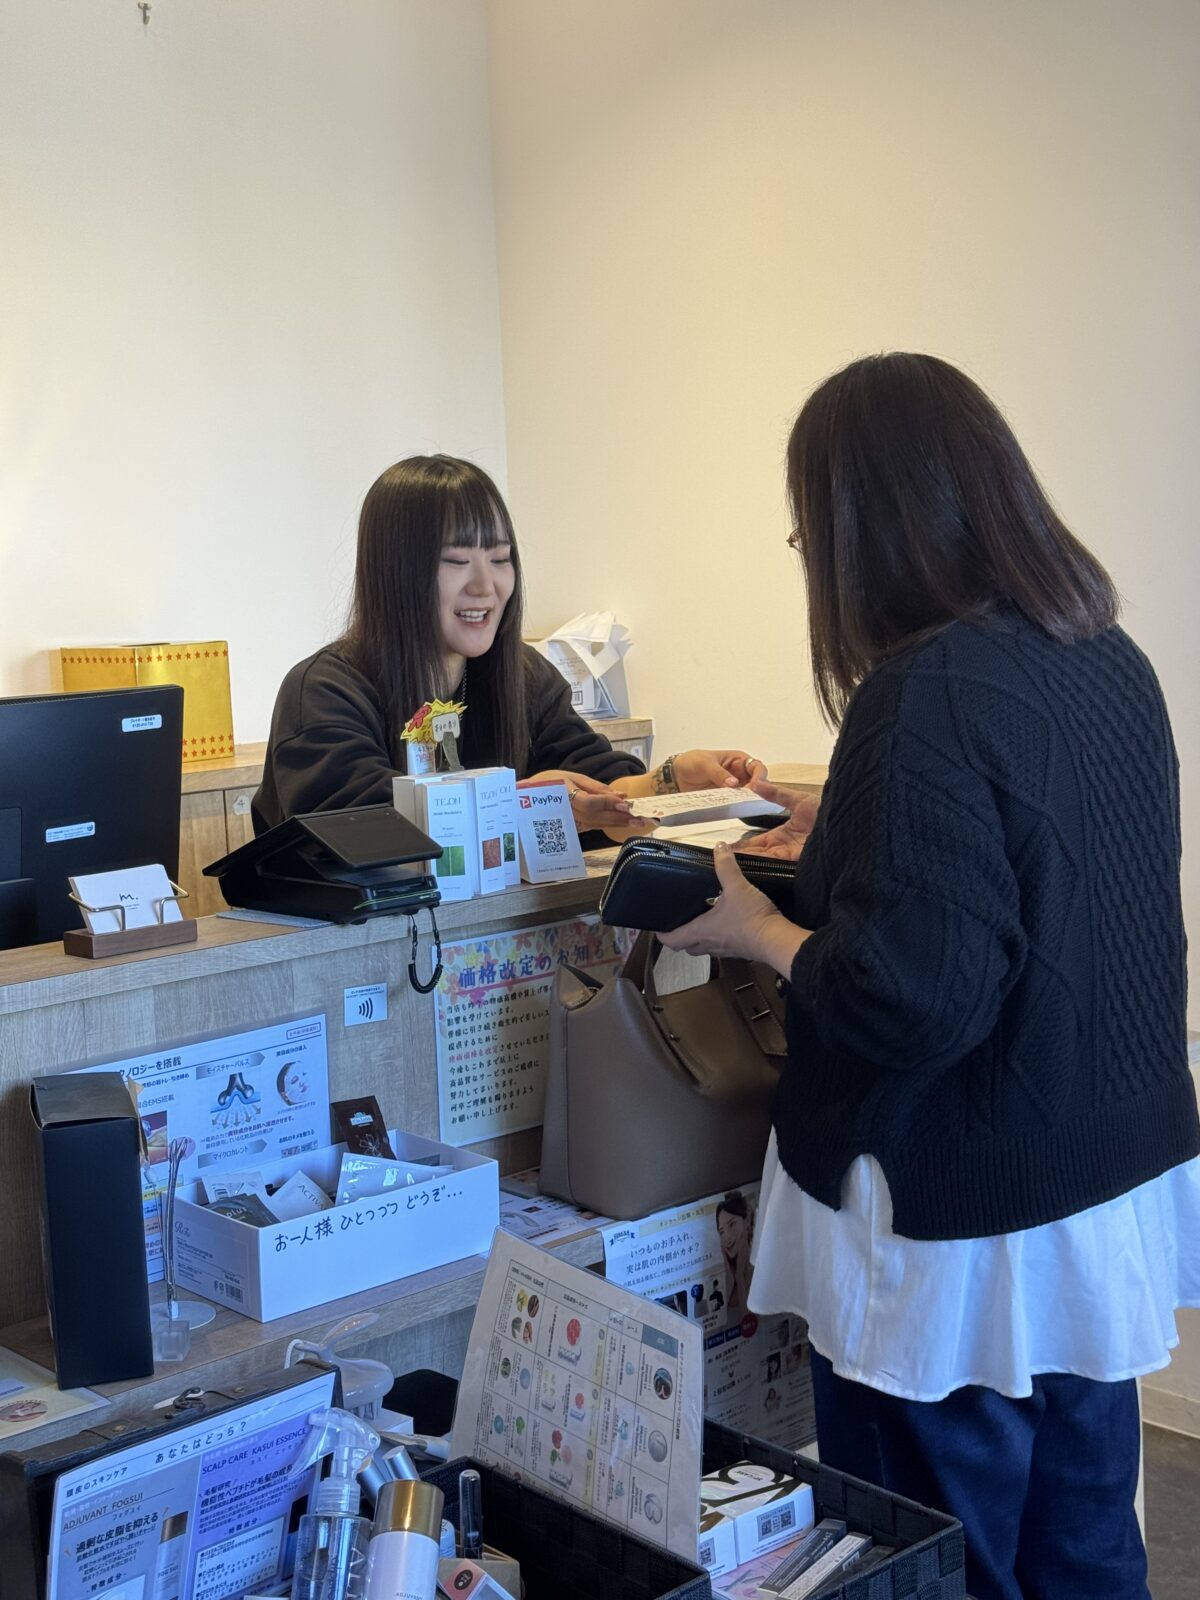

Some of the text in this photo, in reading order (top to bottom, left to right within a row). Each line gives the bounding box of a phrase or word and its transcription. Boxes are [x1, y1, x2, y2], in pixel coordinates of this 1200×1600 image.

[532, 795, 563, 806] PayPay
[275, 1216, 334, 1253] お一人様
[202, 1460, 227, 1475] SCALP
[228, 1450, 249, 1465] CARE
[252, 1441, 275, 1456] KASUI
[276, 1427, 307, 1446] ESSENCE
[65, 1466, 128, 1498] 頭皮のスキンケア
[63, 1505, 108, 1531] ADJUVANT
[112, 1492, 143, 1511] FOGSUI
[76, 1511, 159, 1554] 過剰な皮脂を抑える
